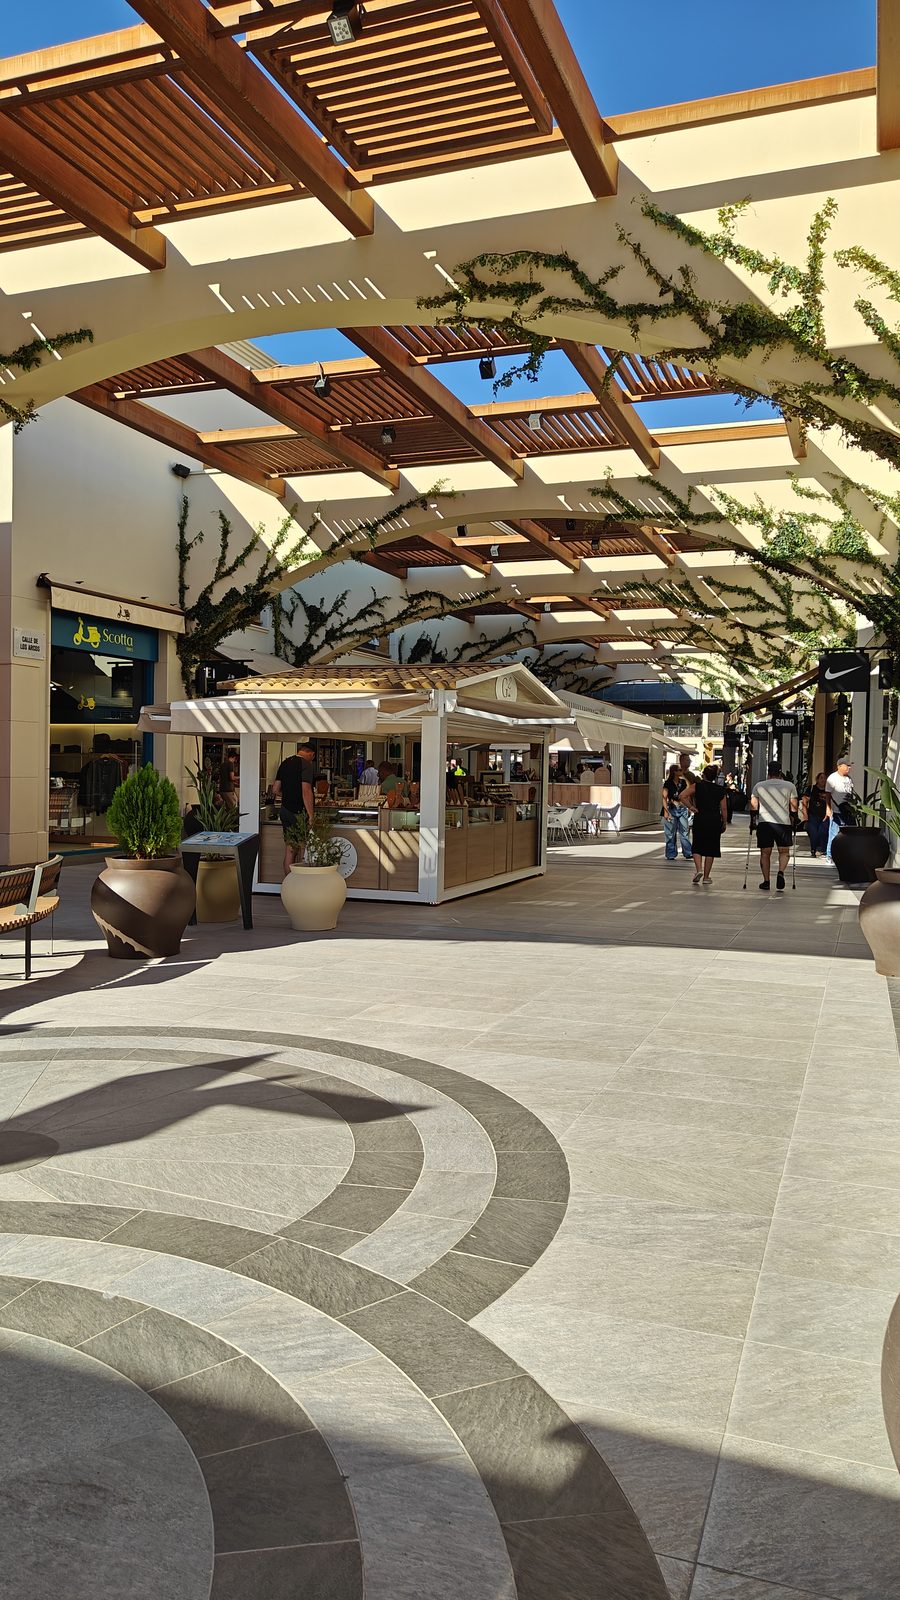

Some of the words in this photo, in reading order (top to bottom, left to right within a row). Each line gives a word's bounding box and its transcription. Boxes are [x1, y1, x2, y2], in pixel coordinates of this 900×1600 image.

[21, 635, 33, 643] CALLE
[102, 628, 134, 647] Scotta
[28, 644, 40, 652] ARCOS
[775, 718, 795, 727] SAXO
